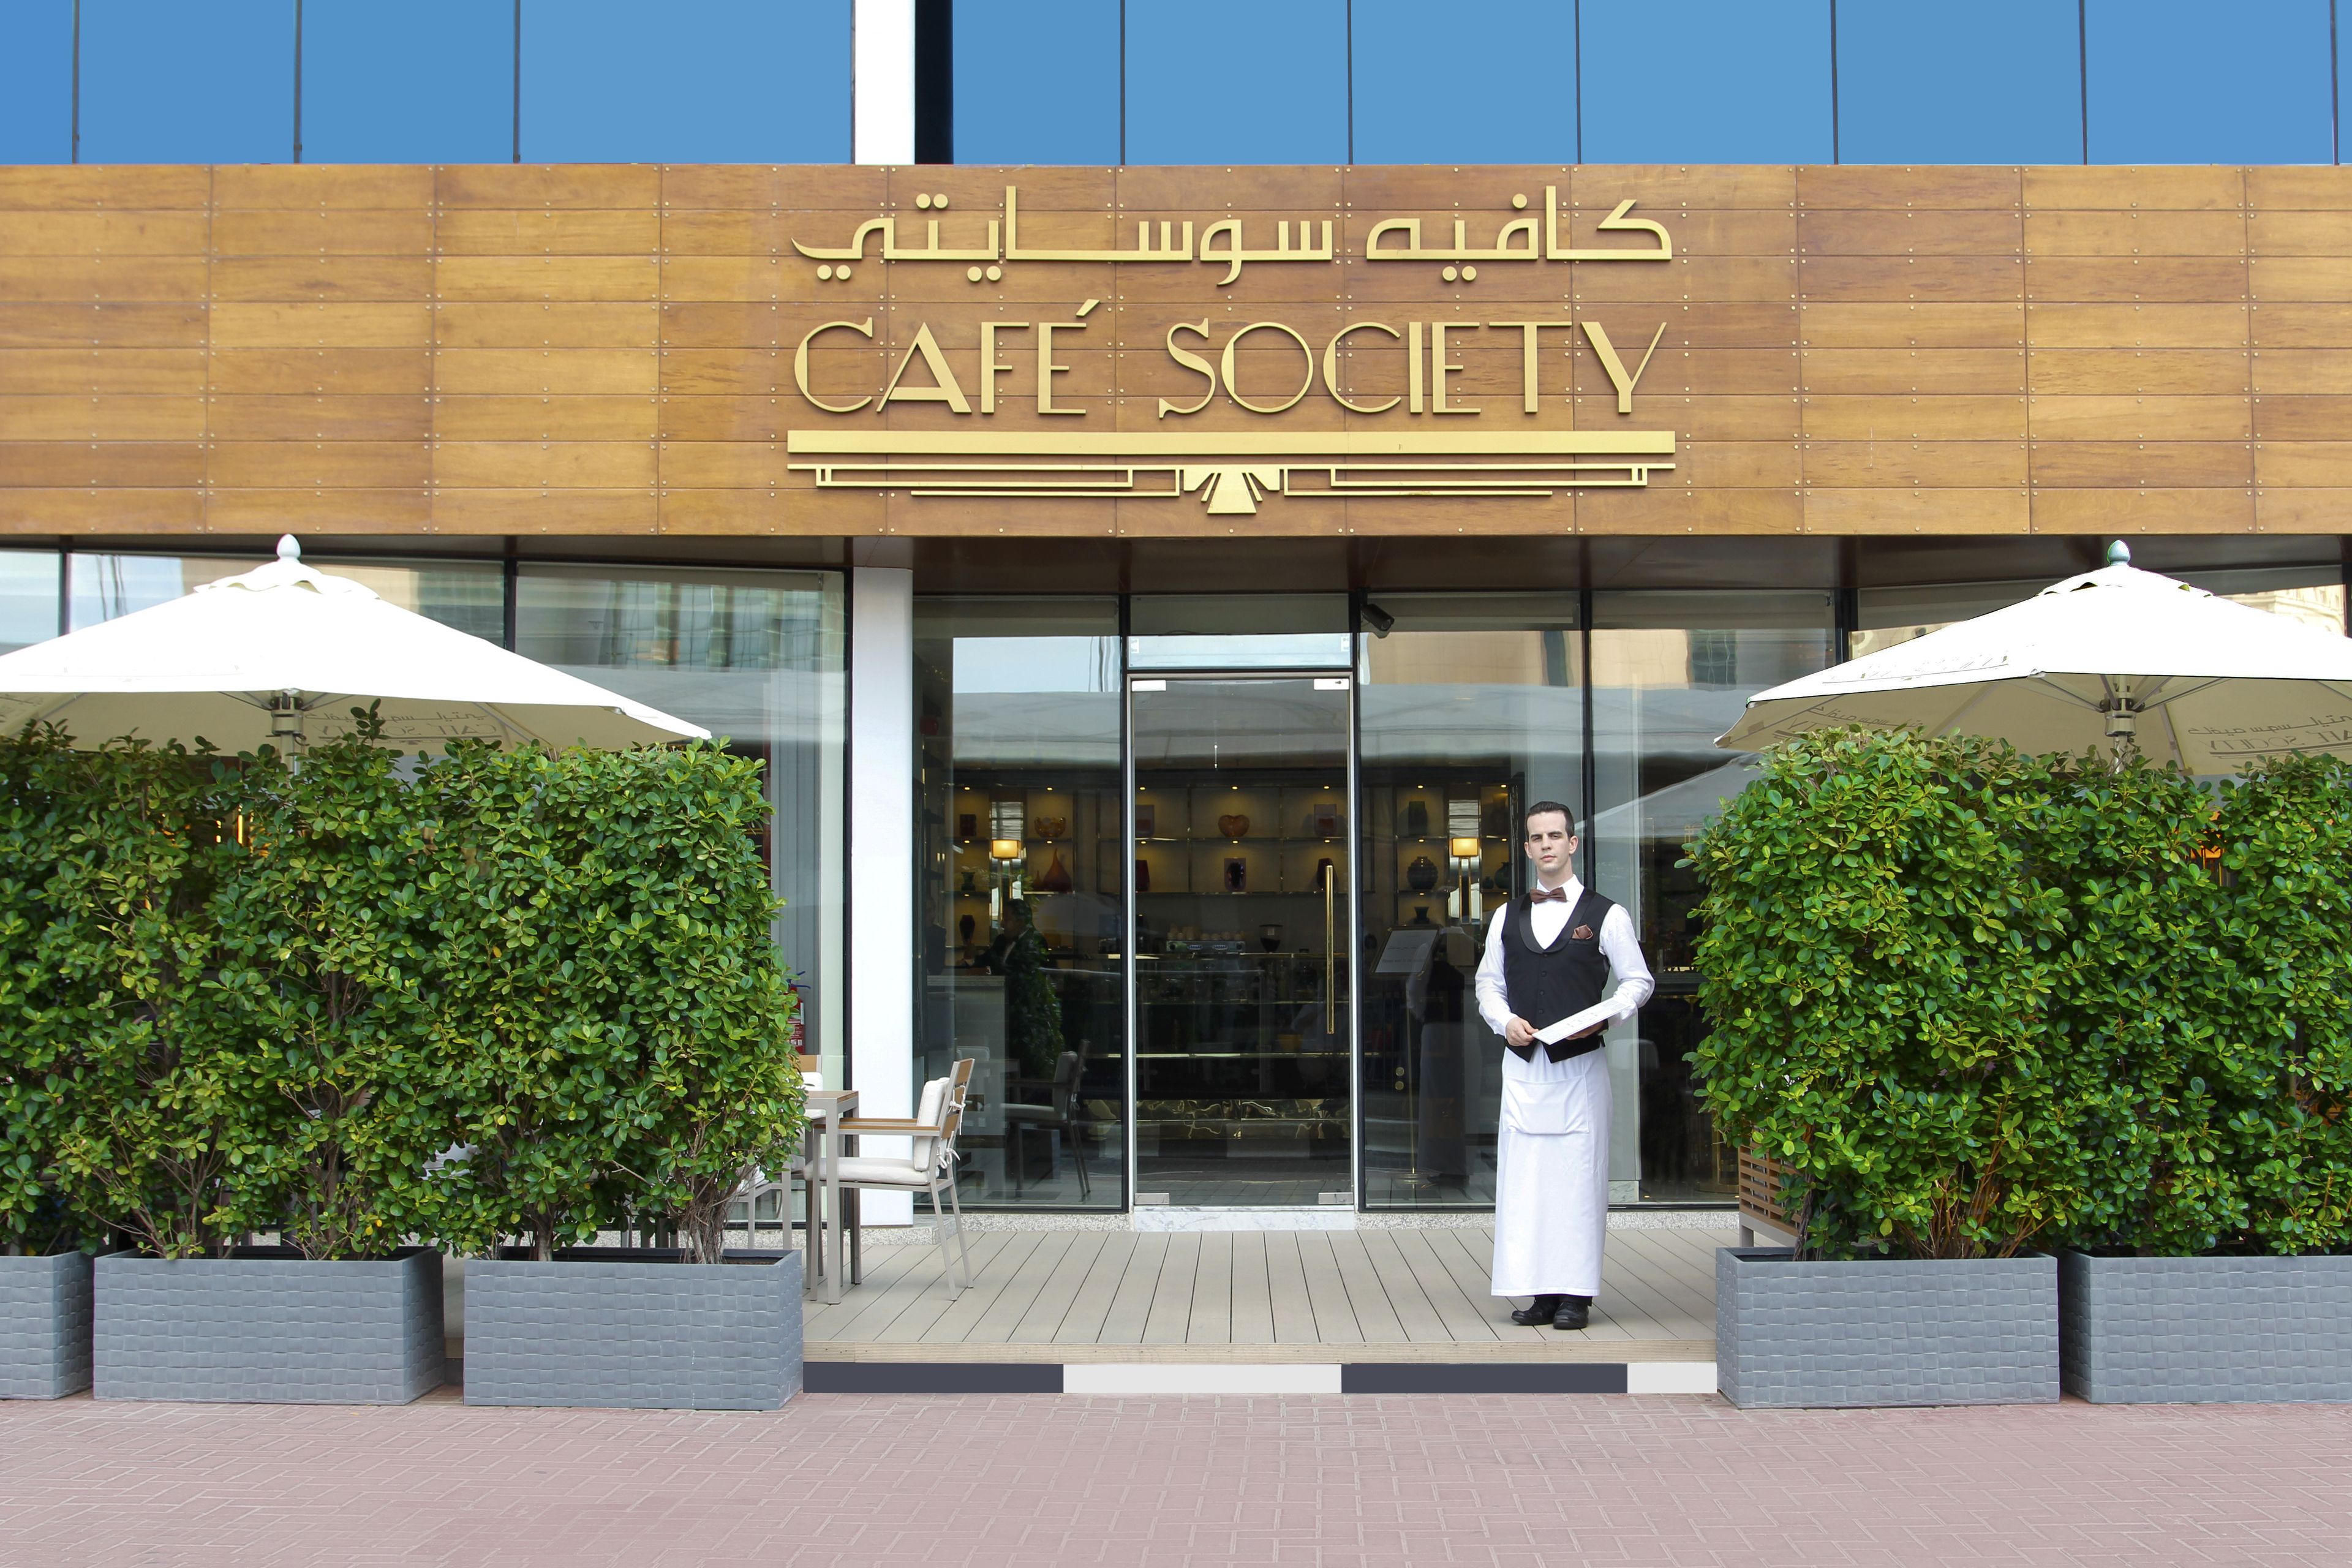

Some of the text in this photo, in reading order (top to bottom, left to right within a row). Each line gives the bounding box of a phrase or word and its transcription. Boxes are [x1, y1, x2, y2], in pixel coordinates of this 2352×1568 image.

[791, 186, 1672, 286] كافيه سوسايتي
[794, 299, 1667, 420] CAFÉ SOCIETY
